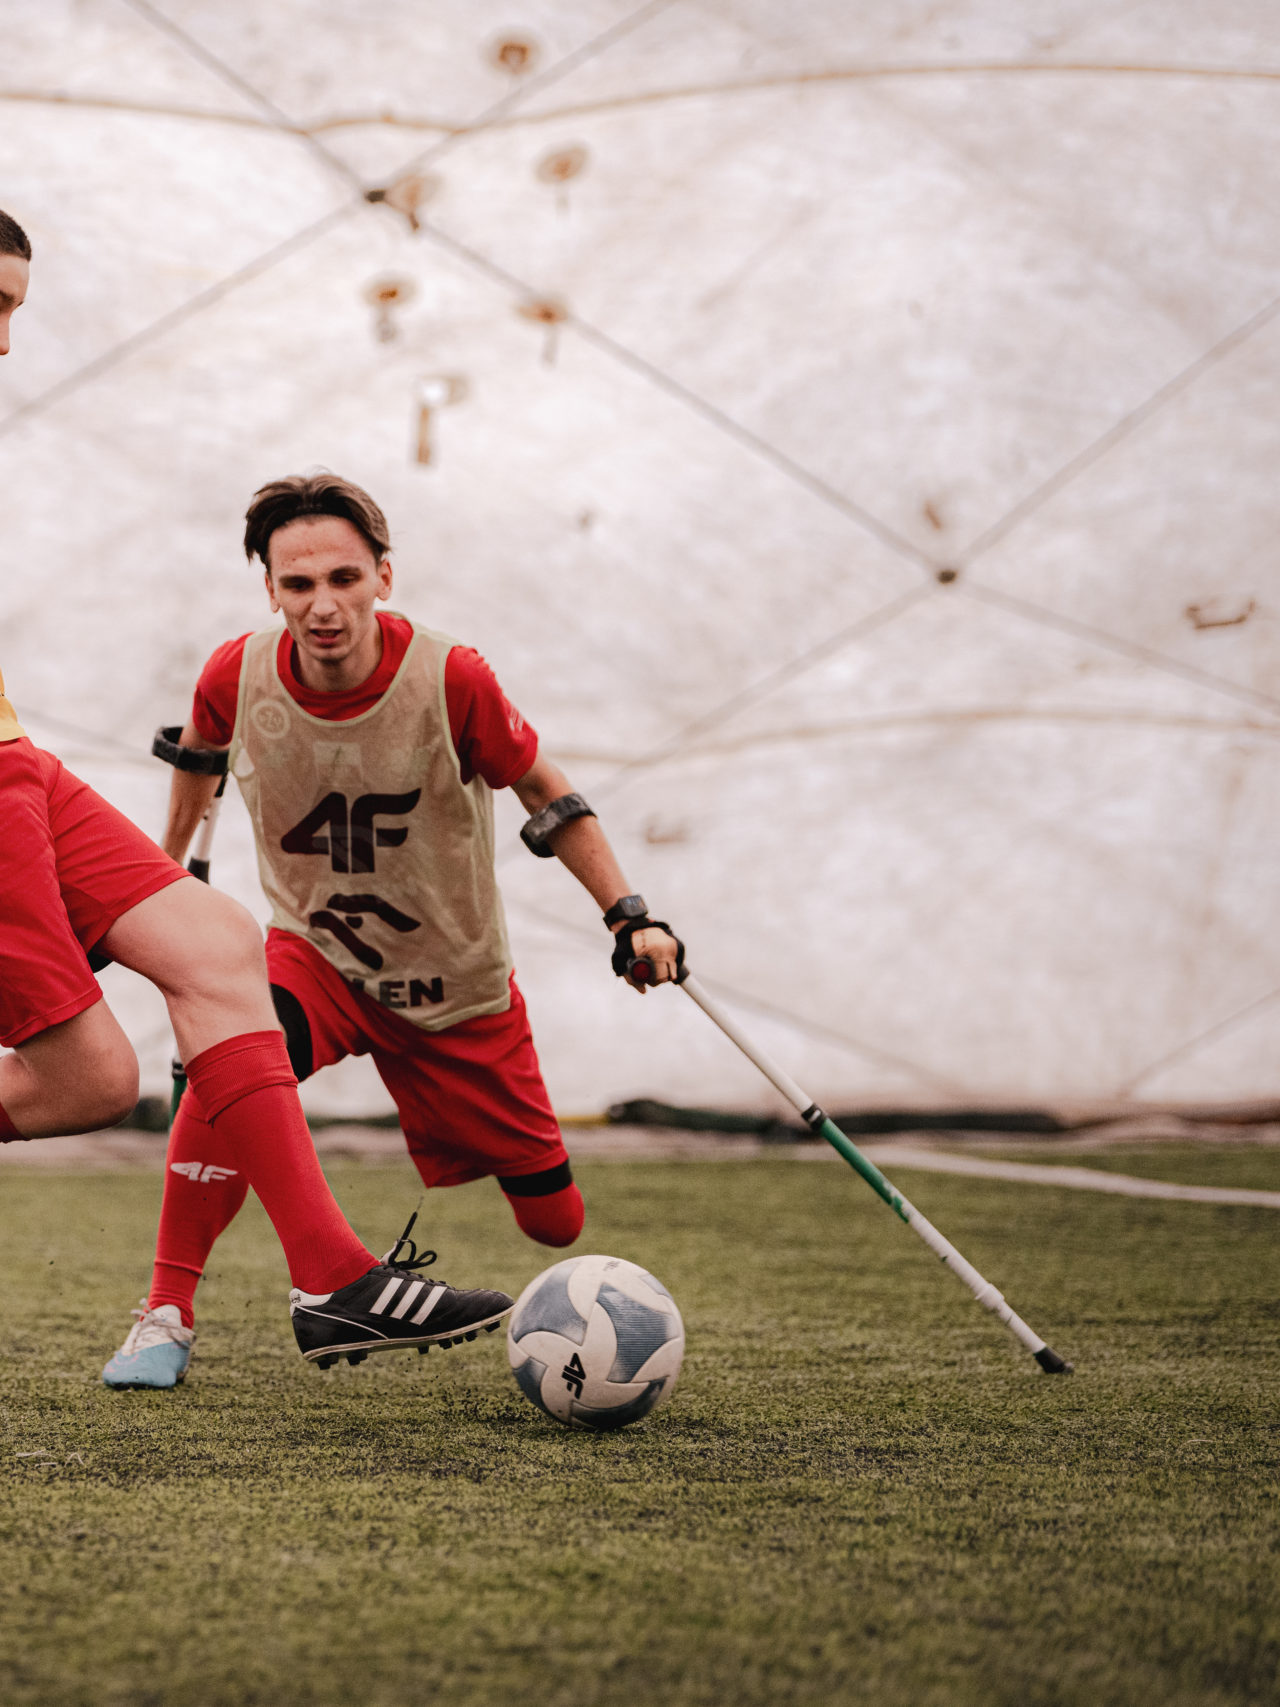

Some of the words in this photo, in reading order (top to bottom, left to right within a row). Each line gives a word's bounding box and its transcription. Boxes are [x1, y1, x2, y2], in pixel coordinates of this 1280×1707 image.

[281, 788, 421, 874] 4F
[170, 1162, 238, 1183] 4F
[562, 1352, 586, 1400] 4F
